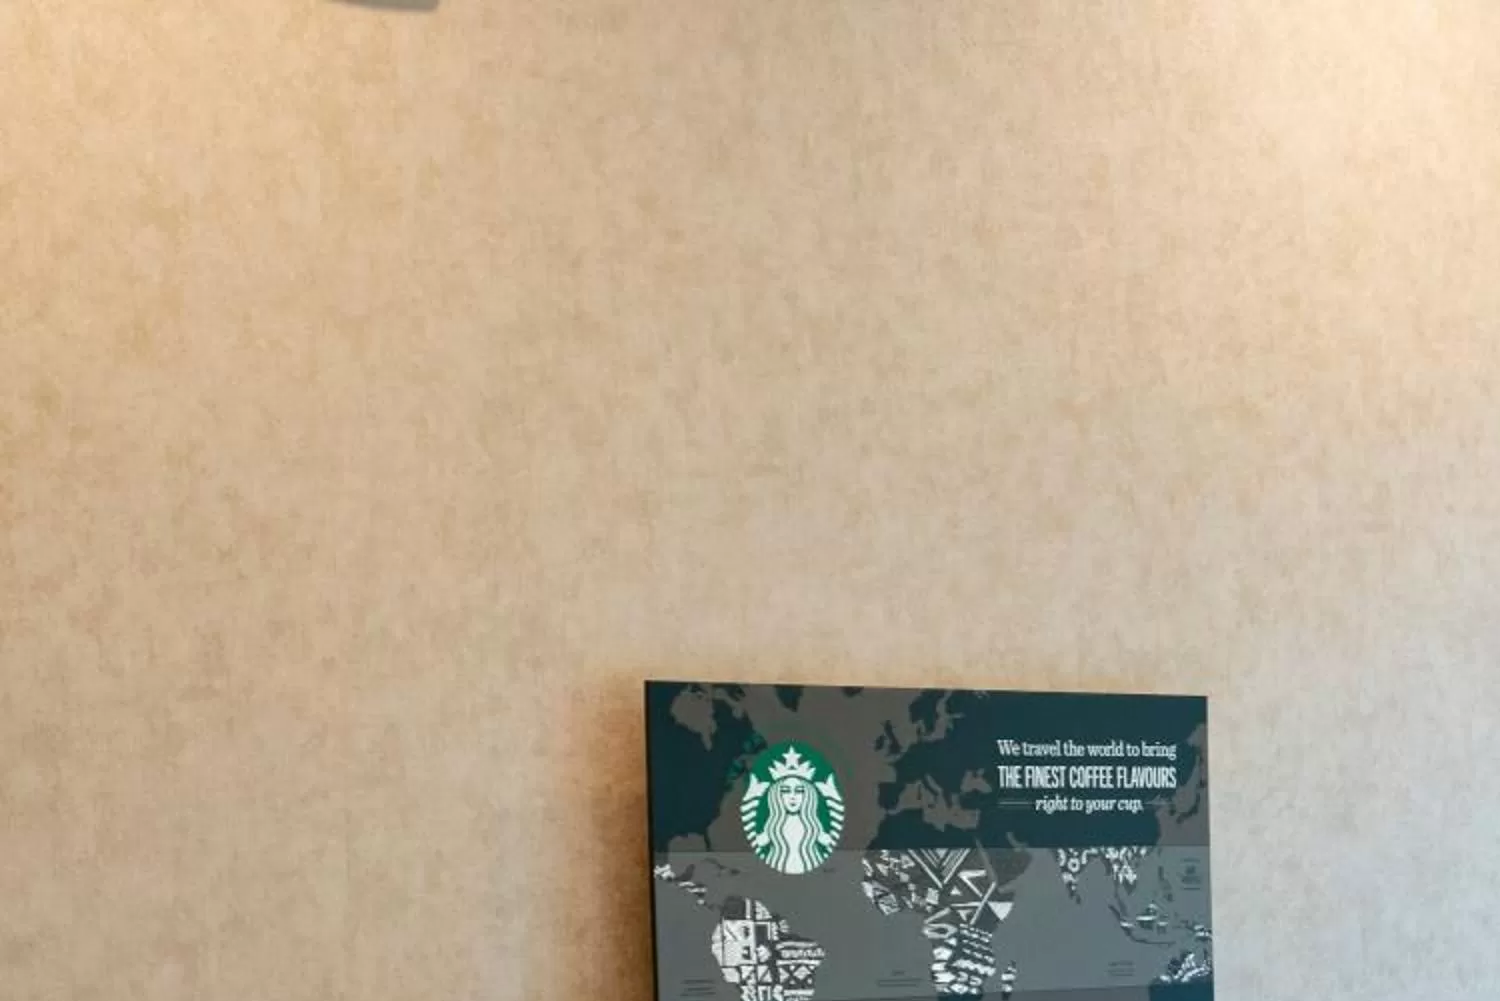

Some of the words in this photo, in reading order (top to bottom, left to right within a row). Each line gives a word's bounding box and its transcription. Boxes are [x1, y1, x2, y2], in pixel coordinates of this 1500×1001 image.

[997, 740, 1020, 757] We
[1022, 740, 1061, 757] travel
[1063, 740, 1085, 757] the
[1087, 740, 1124, 757] world
[1126, 742, 1140, 757] to
[1141, 741, 1176, 761] bring
[997, 766, 1021, 788] THE
[1025, 766, 1066, 788] FINEST
[1069, 766, 1114, 788] COFFEE
[1116, 766, 1177, 789] FLAVOURS
[1035, 795, 1068, 815] right
[1071, 797, 1084, 811] to
[1086, 799, 1116, 815] your
